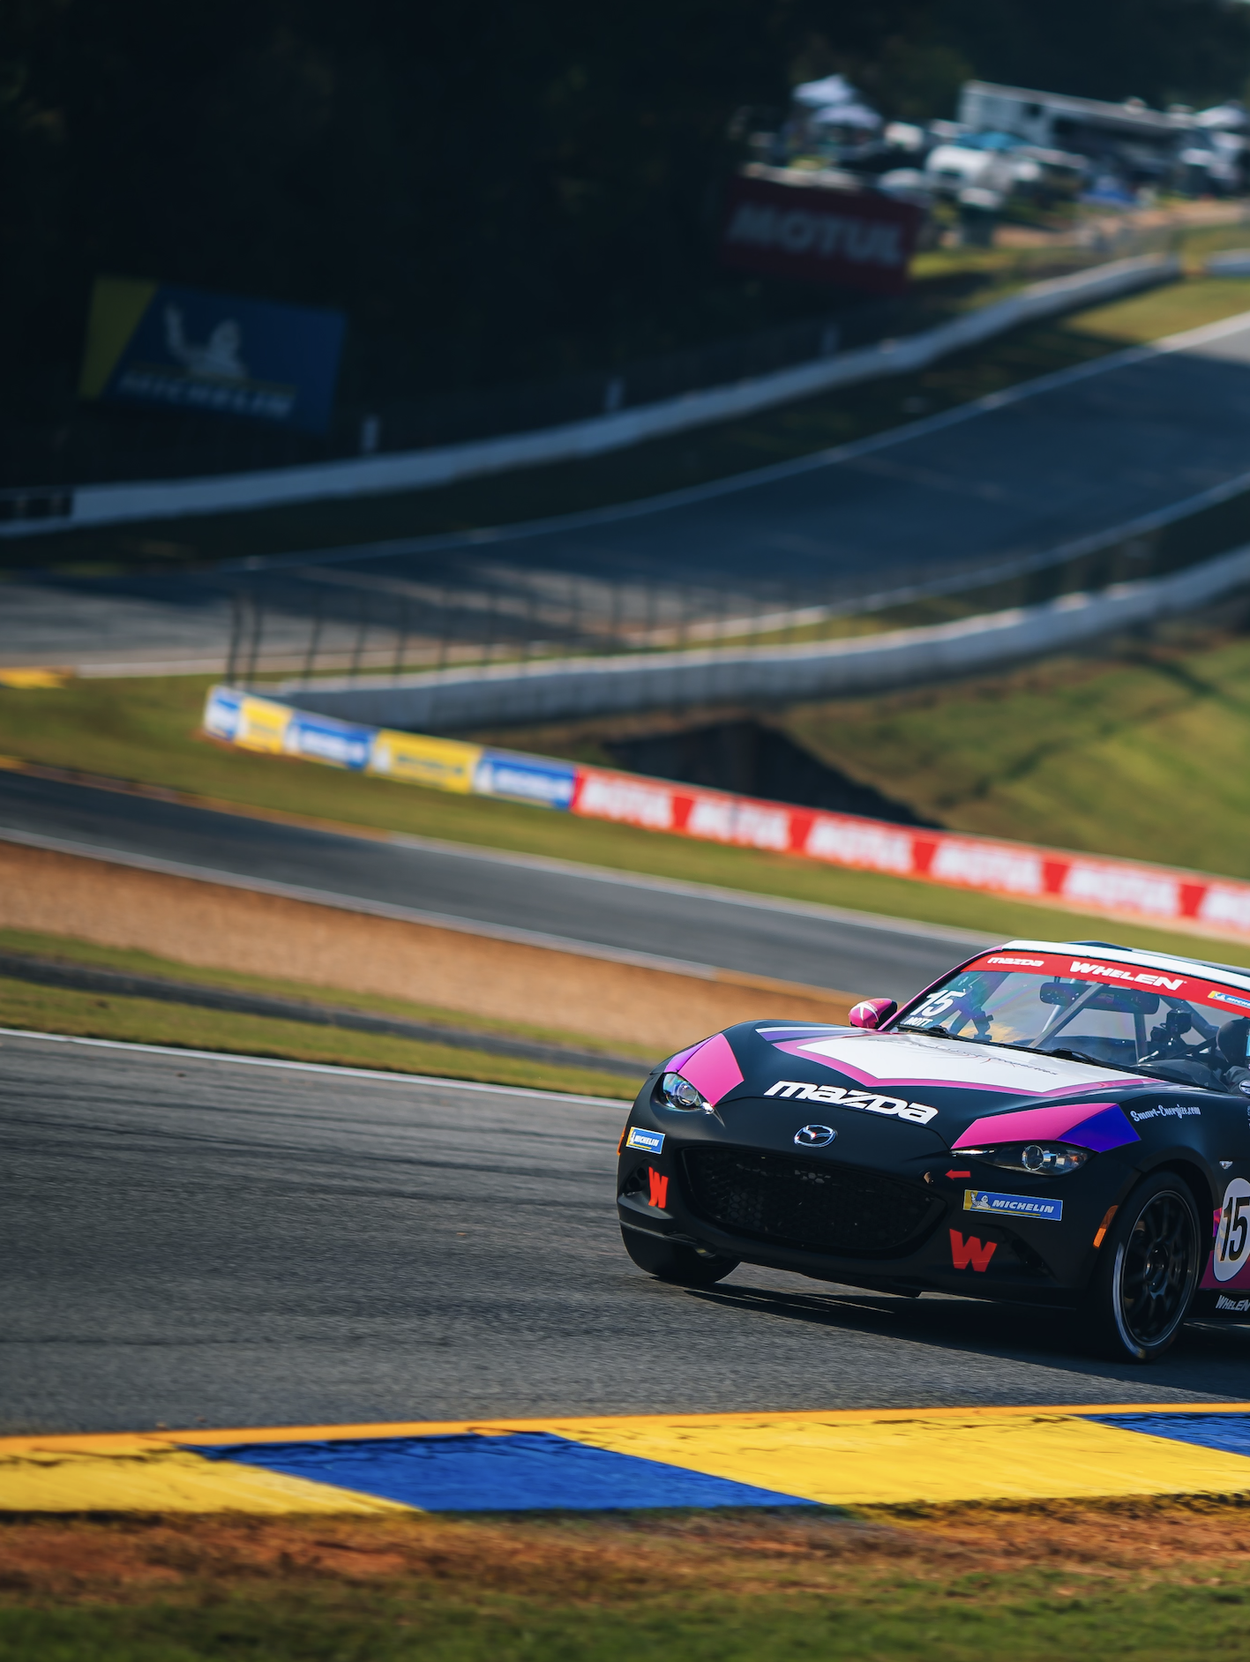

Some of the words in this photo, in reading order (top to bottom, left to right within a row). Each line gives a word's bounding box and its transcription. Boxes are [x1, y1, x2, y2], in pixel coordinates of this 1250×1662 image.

[727, 202, 902, 268] MOTUL
[987, 956, 1045, 968] mazda
[1070, 961, 1184, 991] WHELEN
[910, 989, 967, 1017] 15
[904, 1017, 934, 1027] MOTT
[764, 1080, 938, 1125] mazda
[1130, 1103, 1202, 1123] Smart-Energize.com
[991, 1199, 1055, 1214] MICHELIN
[1220, 1196, 1250, 1262] 15
[950, 1228, 998, 1272] W
